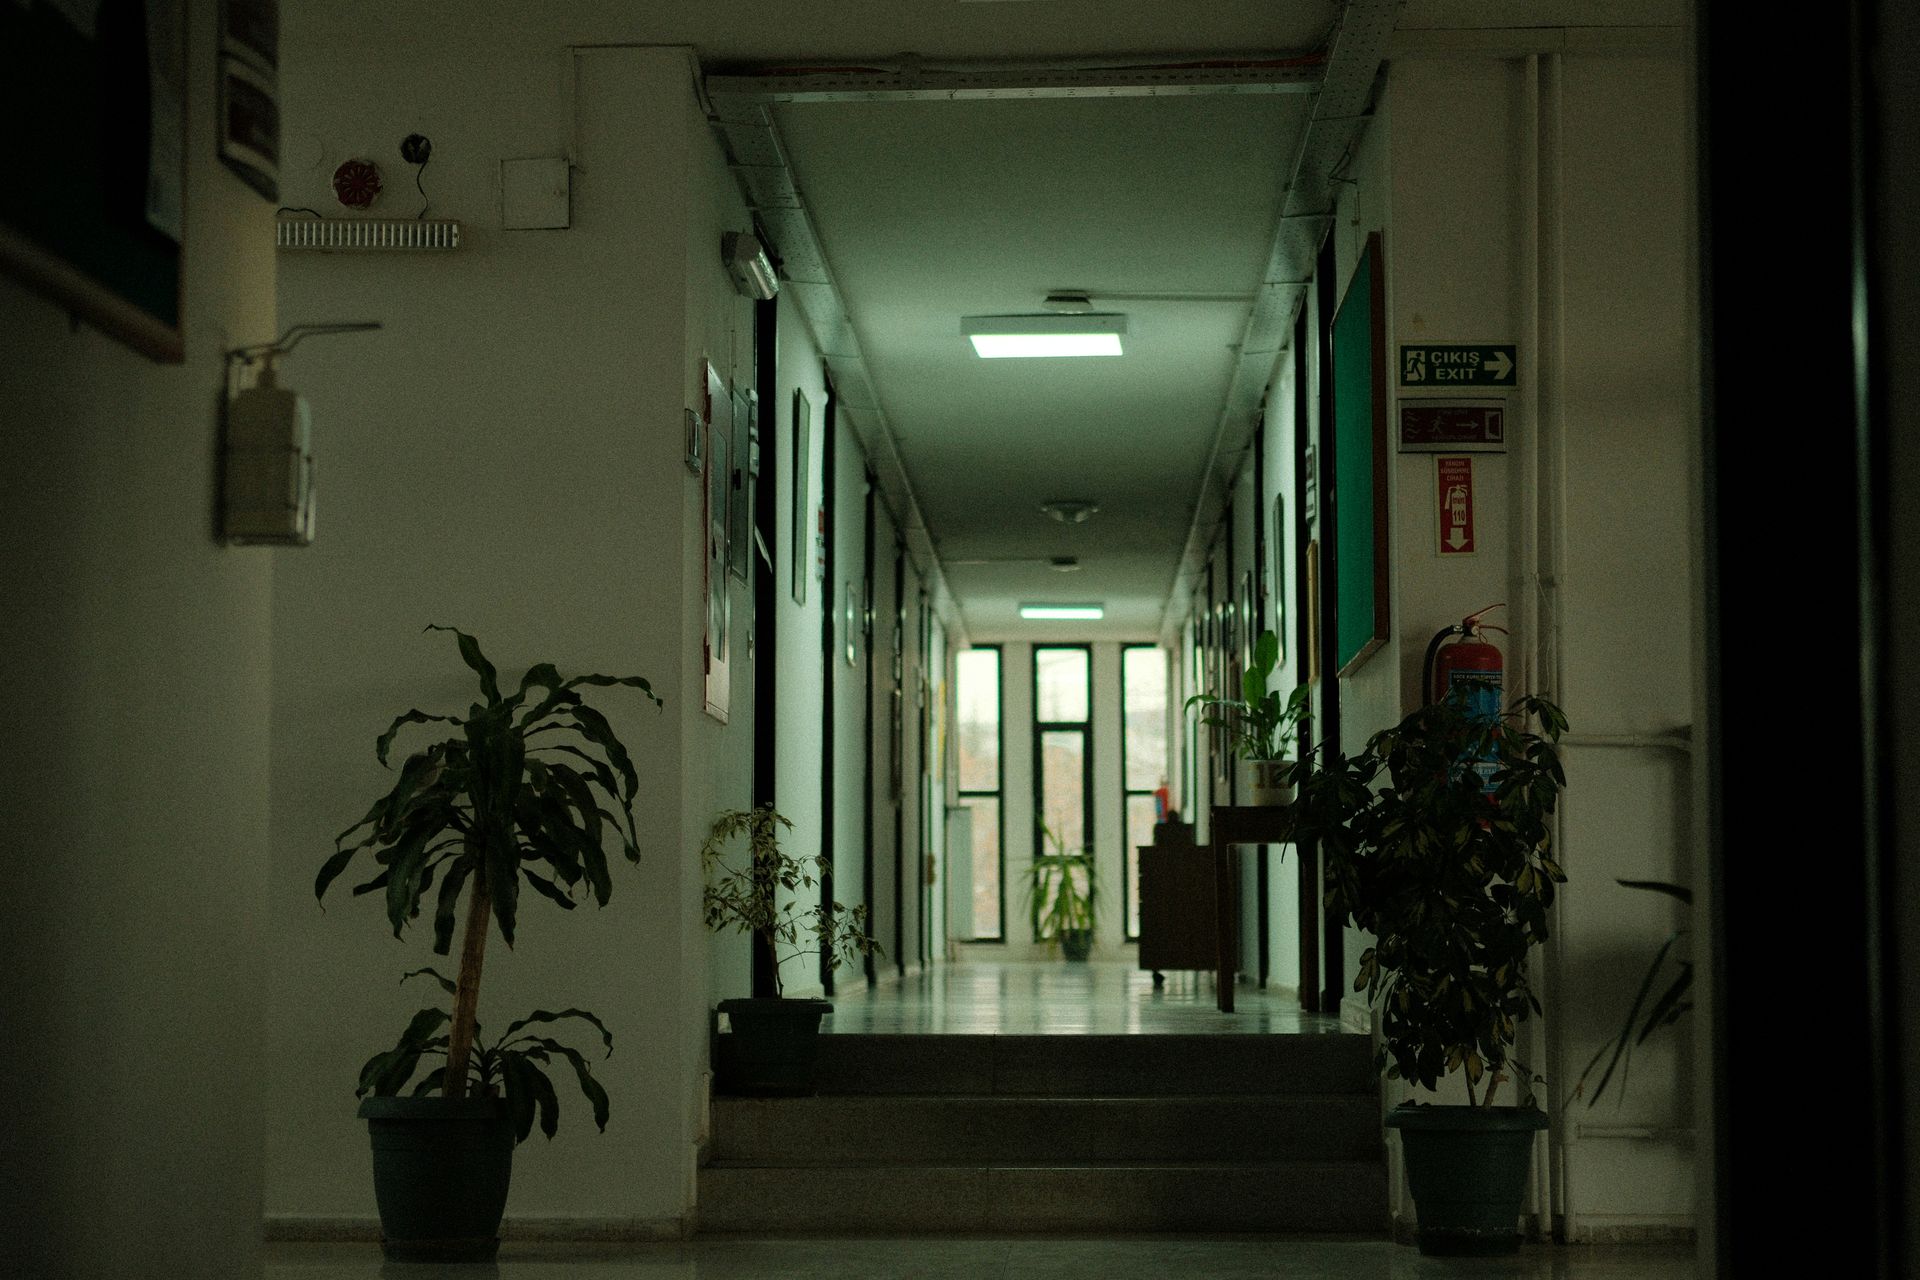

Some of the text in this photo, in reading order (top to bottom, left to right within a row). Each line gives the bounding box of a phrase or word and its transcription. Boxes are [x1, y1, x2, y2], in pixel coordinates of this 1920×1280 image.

[1431, 351, 1480, 367] ÇIKIŞ
[1435, 368, 1477, 380] EXIT
[1454, 510, 1465, 521] 110
